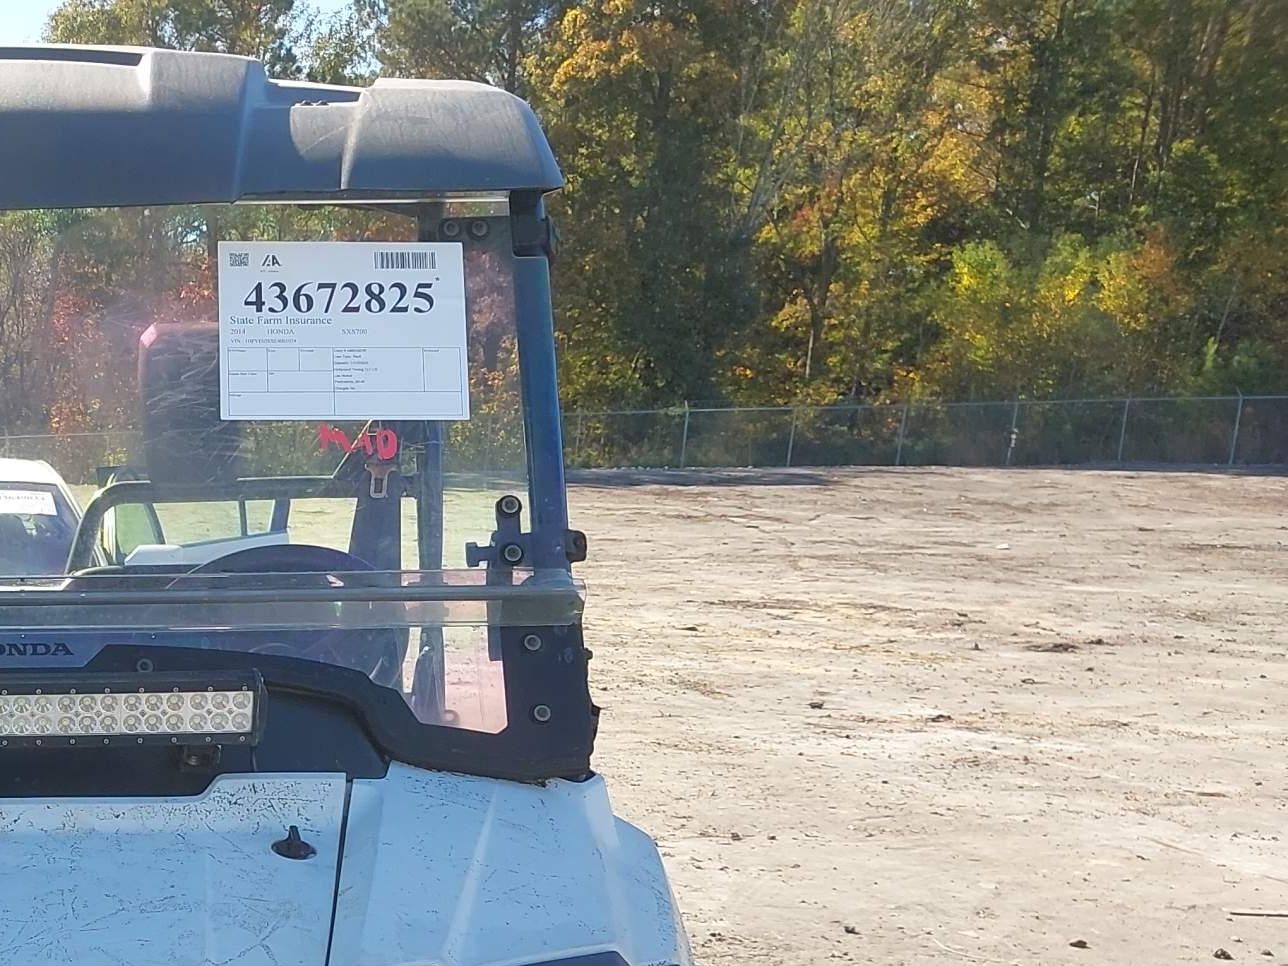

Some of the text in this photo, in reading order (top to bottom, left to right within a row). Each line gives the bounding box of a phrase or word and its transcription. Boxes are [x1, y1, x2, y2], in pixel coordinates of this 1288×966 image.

[230, 316, 333, 325] State Farm Insurance
